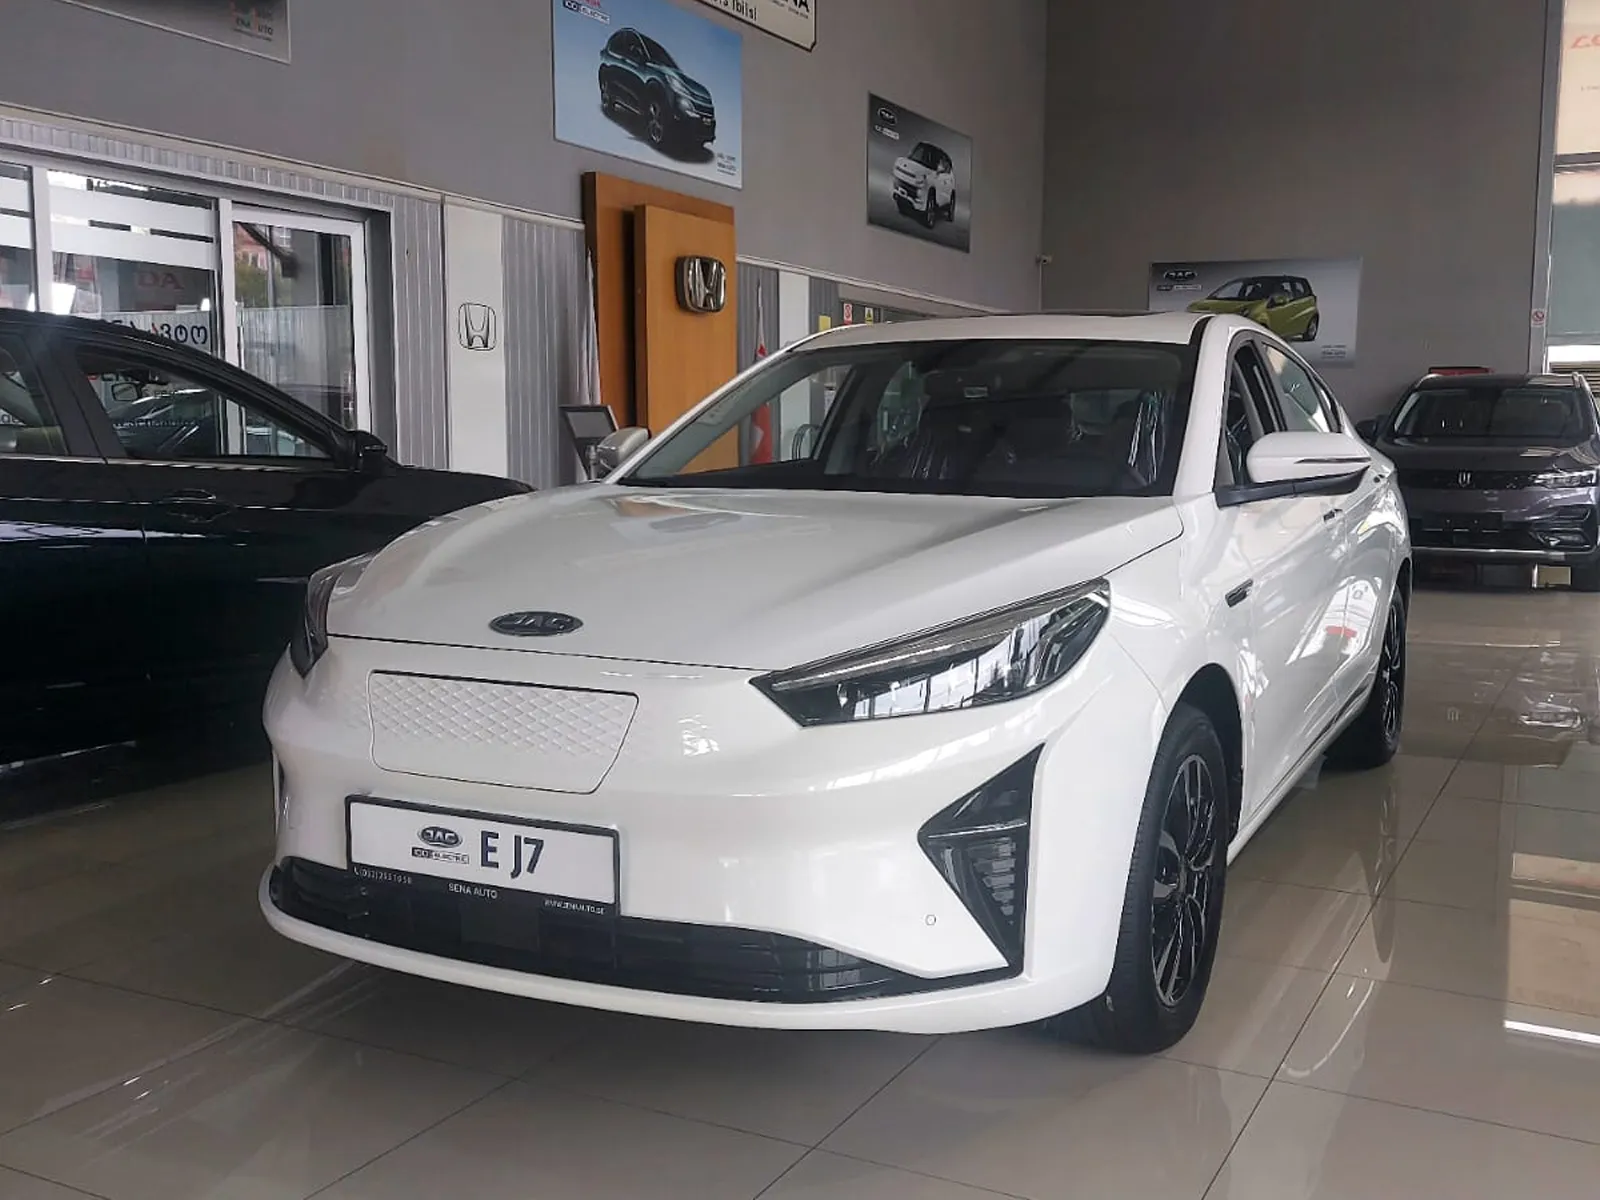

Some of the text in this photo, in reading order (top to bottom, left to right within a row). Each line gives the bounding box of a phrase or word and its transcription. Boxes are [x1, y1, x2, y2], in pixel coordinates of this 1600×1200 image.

[424, 829, 456, 844] JAC
[480, 830, 544, 879] E J7
[448, 883, 498, 900] SENA AUTO
